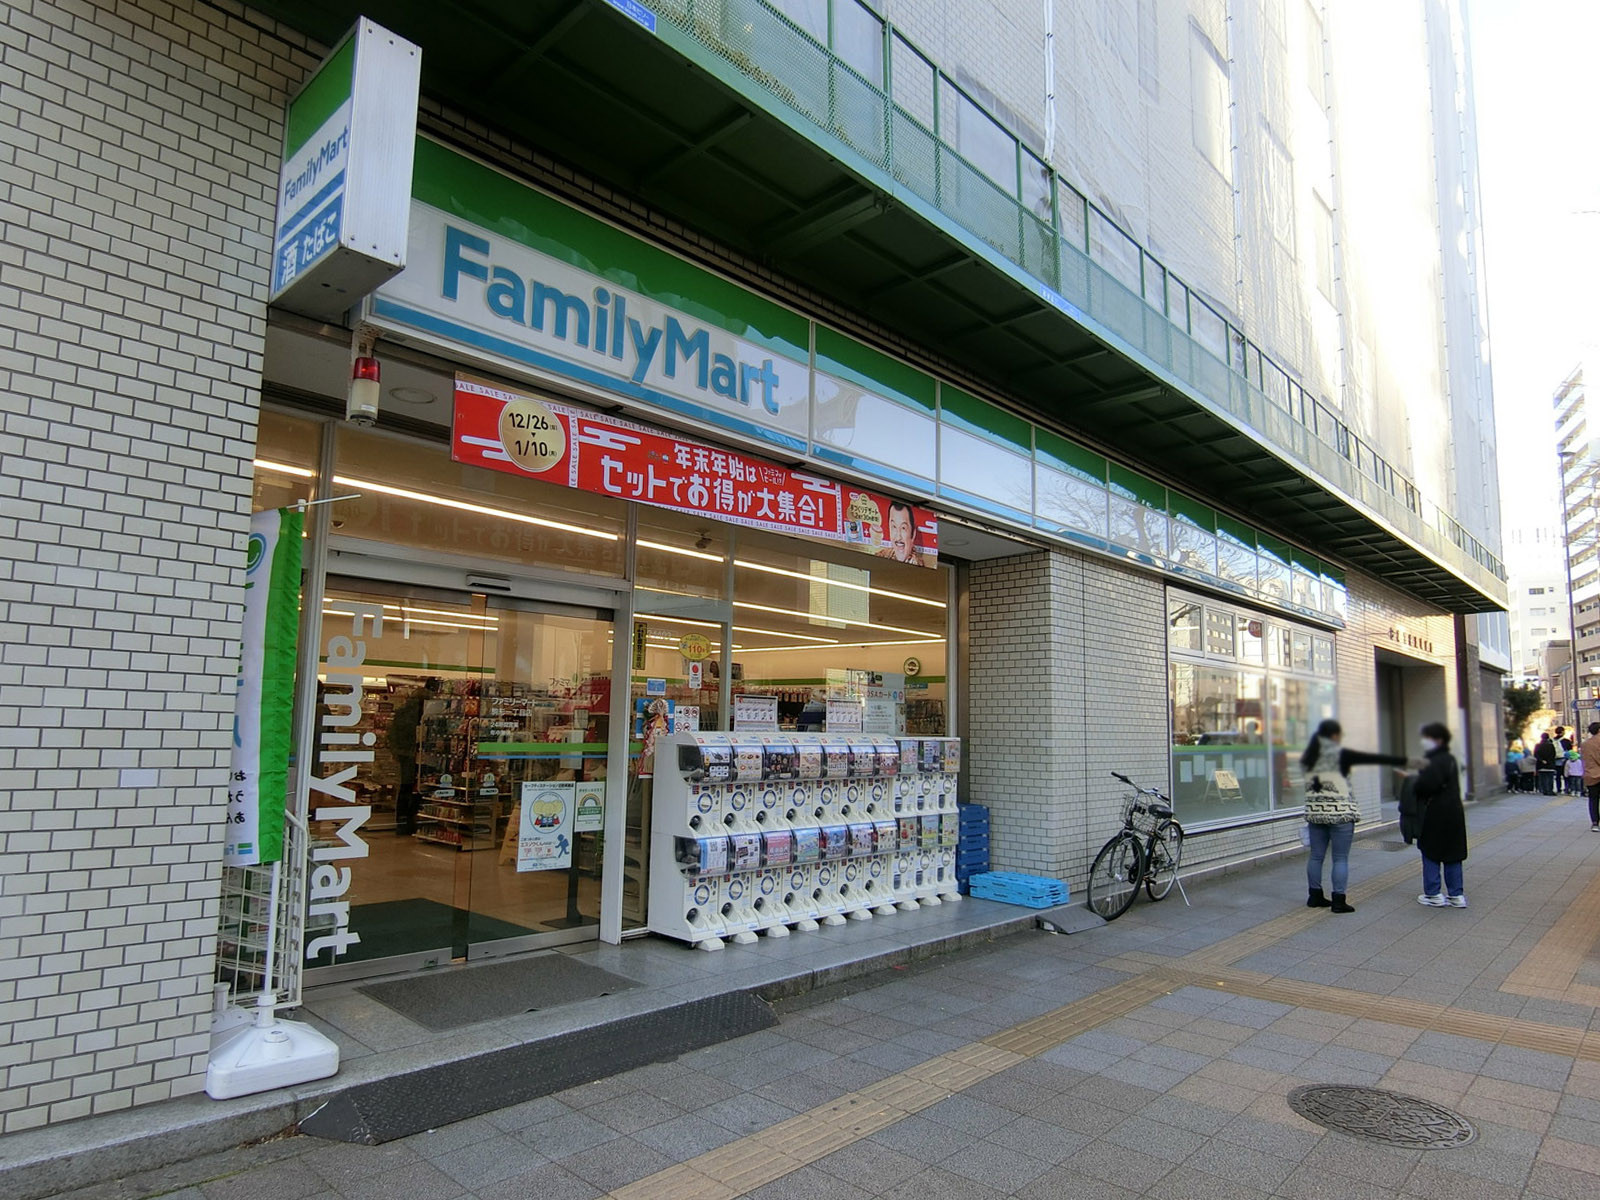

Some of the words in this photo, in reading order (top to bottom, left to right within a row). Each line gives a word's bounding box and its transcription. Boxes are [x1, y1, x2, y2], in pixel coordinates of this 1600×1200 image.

[284, 124, 348, 205] FamilyMart
[281, 240, 298, 285] 酒
[302, 211, 337, 265] たばこ
[441, 224, 780, 417] FamilyMart
[479, 387, 500, 397] SALE
[548, 404, 566, 413] SALE
[509, 412, 549, 430] 12/26
[580, 410, 598, 420] SALE
[600, 415, 619, 425] SALE
[515, 440, 548, 457] 1/10
[570, 432, 578, 452] SALE
[570, 454, 578, 474] SALE
[674, 443, 757, 483] 年末年始は
[601, 455, 824, 528] セットでお得が大集合!
[725, 515, 739, 524] SALE
[491, 697, 537, 707] ファミリーマート
[307, 600, 384, 960] FamilyMart
